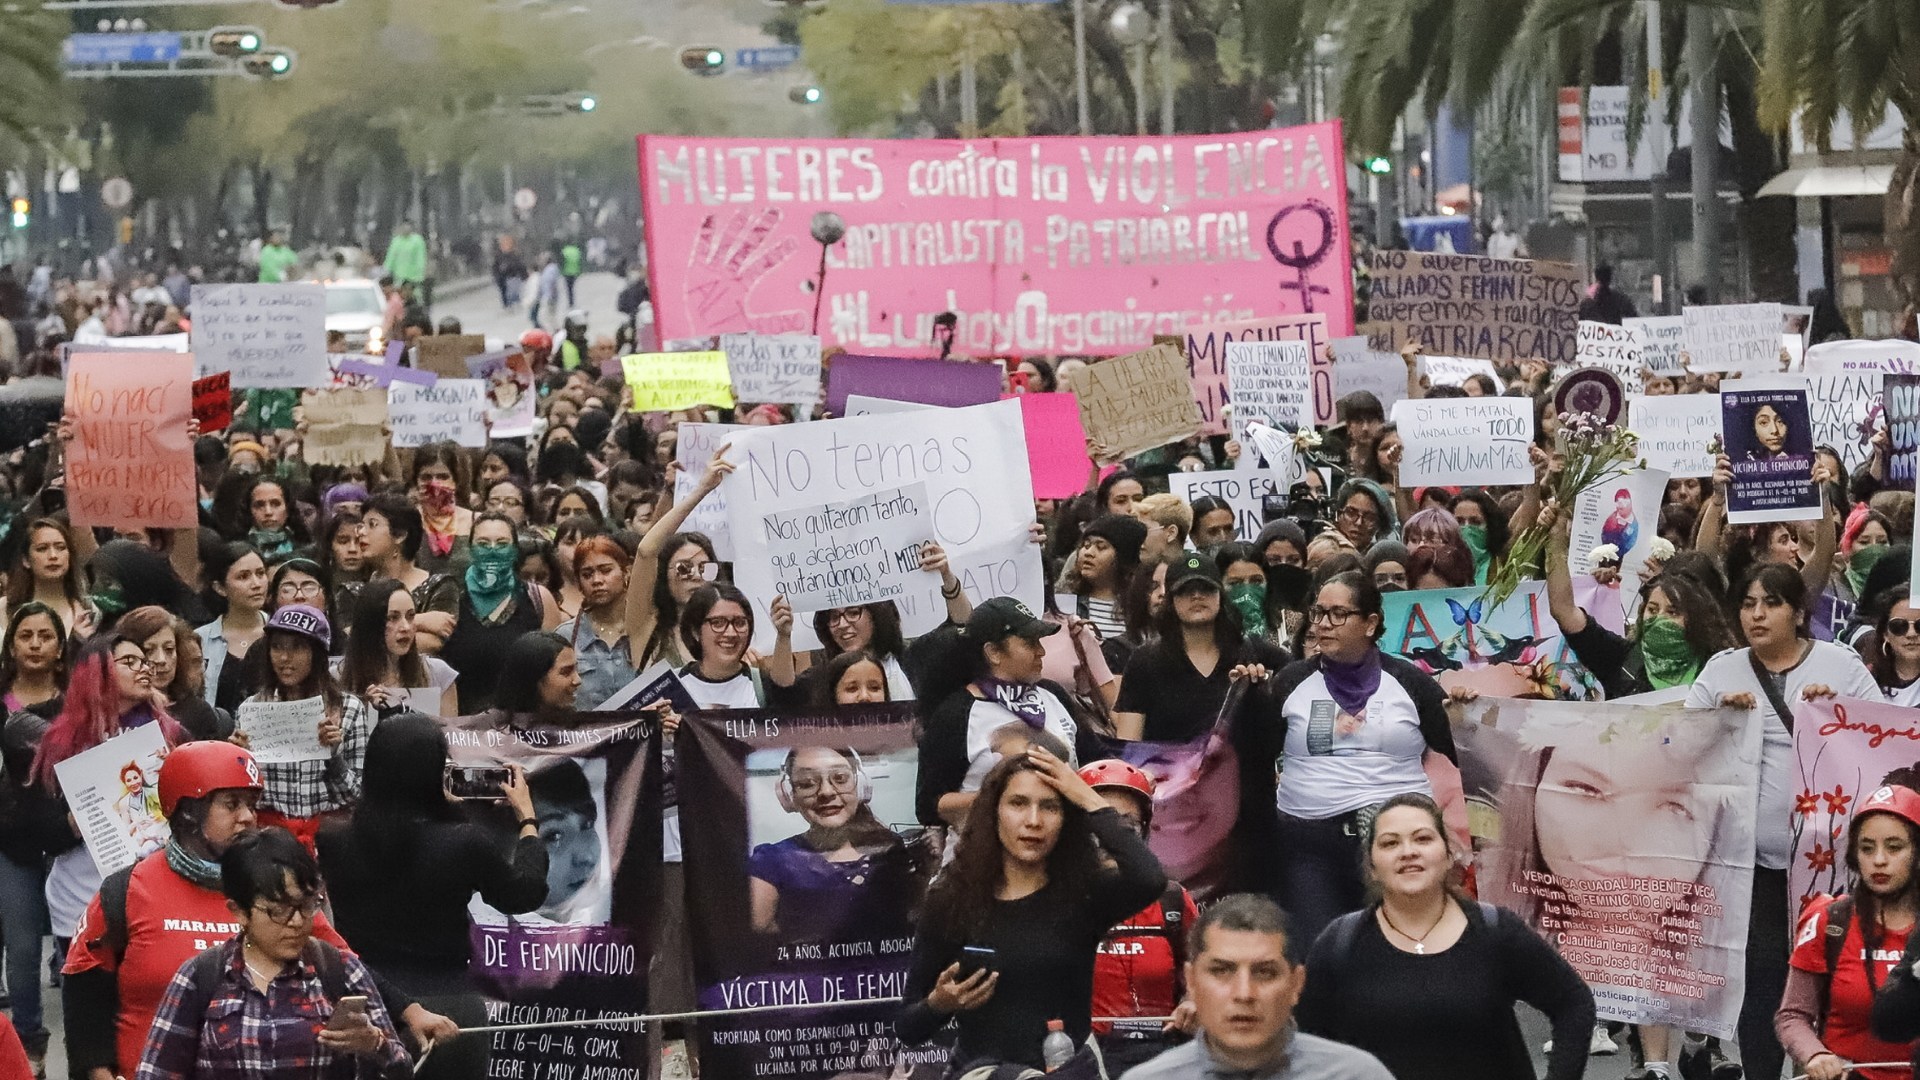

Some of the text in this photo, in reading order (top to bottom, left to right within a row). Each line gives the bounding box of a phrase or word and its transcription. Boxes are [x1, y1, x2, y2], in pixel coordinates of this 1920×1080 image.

[656, 135, 1330, 205] MUJERES contra la VIOLENCIA
[824, 219, 1025, 269] CAPITALISTA
[1374, 250, 1407, 270] NO
[1370, 274, 1581, 307] ALIADOS FEMINISTOS
[1370, 301, 1580, 331] queremos traidores
[1367, 325, 1579, 363] del PATRIARCADO
[1706, 322, 1757, 342] HERMANA
[1231, 345, 1308, 365] SOY FEMINISTA
[1842, 358, 1878, 370] NO MÁS
[70, 371, 104, 417] No
[391, 412, 417, 426] me
[429, 411, 460, 425] seca
[1441, 406, 1459, 420] ME
[1635, 404, 1717, 435] Por un país
[1413, 417, 1526, 440] VANDALICEN TODO
[81, 419, 160, 465] MUJER
[70, 462, 118, 491] Para
[747, 431, 973, 502] No temas
[1732, 459, 1810, 474] VÍCTIMA DE FEMINICIDIO
[1187, 478, 1271, 502] ESTO ES
[763, 489, 920, 545] Nos quitaron tanto,
[771, 535, 883, 577] que acabaron
[775, 561, 872, 599] quitándonos
[878, 549, 891, 578] el
[281, 611, 318, 631] OBEY
[487, 731, 505, 748] DE
[557, 729, 602, 745] JAIMES
[725, 717, 780, 738] ELLA ES
[1511, 881, 1690, 913] fue de el 6 julio
[1693, 884, 1717, 900] VEGA
[163, 918, 240, 934] MARABU
[1541, 916, 1561, 928] Era
[1653, 930, 1668, 942] del
[1543, 901, 1702, 931] fue y 17 puñaladas
[484, 934, 636, 975] DE FEMINICIDIO
[777, 947, 790, 961] 24
[1557, 932, 1686, 962] Cuautitlán 21 años, en
[1569, 951, 1582, 963] de
[1584, 952, 1603, 967] San
[1605, 955, 1629, 970] José
[1632, 959, 1640, 971] el
[1640, 960, 1667, 975] Vidrio
[1697, 971, 1727, 988] Romero
[1583, 969, 1611, 984] unido
[1645, 978, 1655, 991] el
[720, 975, 810, 1010] VÍCTIMA
[823, 976, 846, 1003] DE
[545, 1007, 569, 1027] POR
[574, 1009, 587, 1029] EL
[595, 1010, 630, 1032] ACOSO
[633, 1011, 647, 1034] DE
[1616, 1006, 1638, 1018] Vega
[493, 1032, 507, 1050] EL
[713, 1022, 869, 1045] REPORTADA COMO DESAPARECIDA EL
[755, 1049, 949, 1077] LUCHABA POR ACABAR CON LA IMPUNIDAD
[769, 1045, 784, 1060] SIN
[789, 1042, 811, 1057] VIDA
[815, 1041, 825, 1056] EL
[488, 1058, 525, 1079] LEGRE
[533, 1062, 542, 1080] Y
[547, 1062, 576, 1080] MUY
